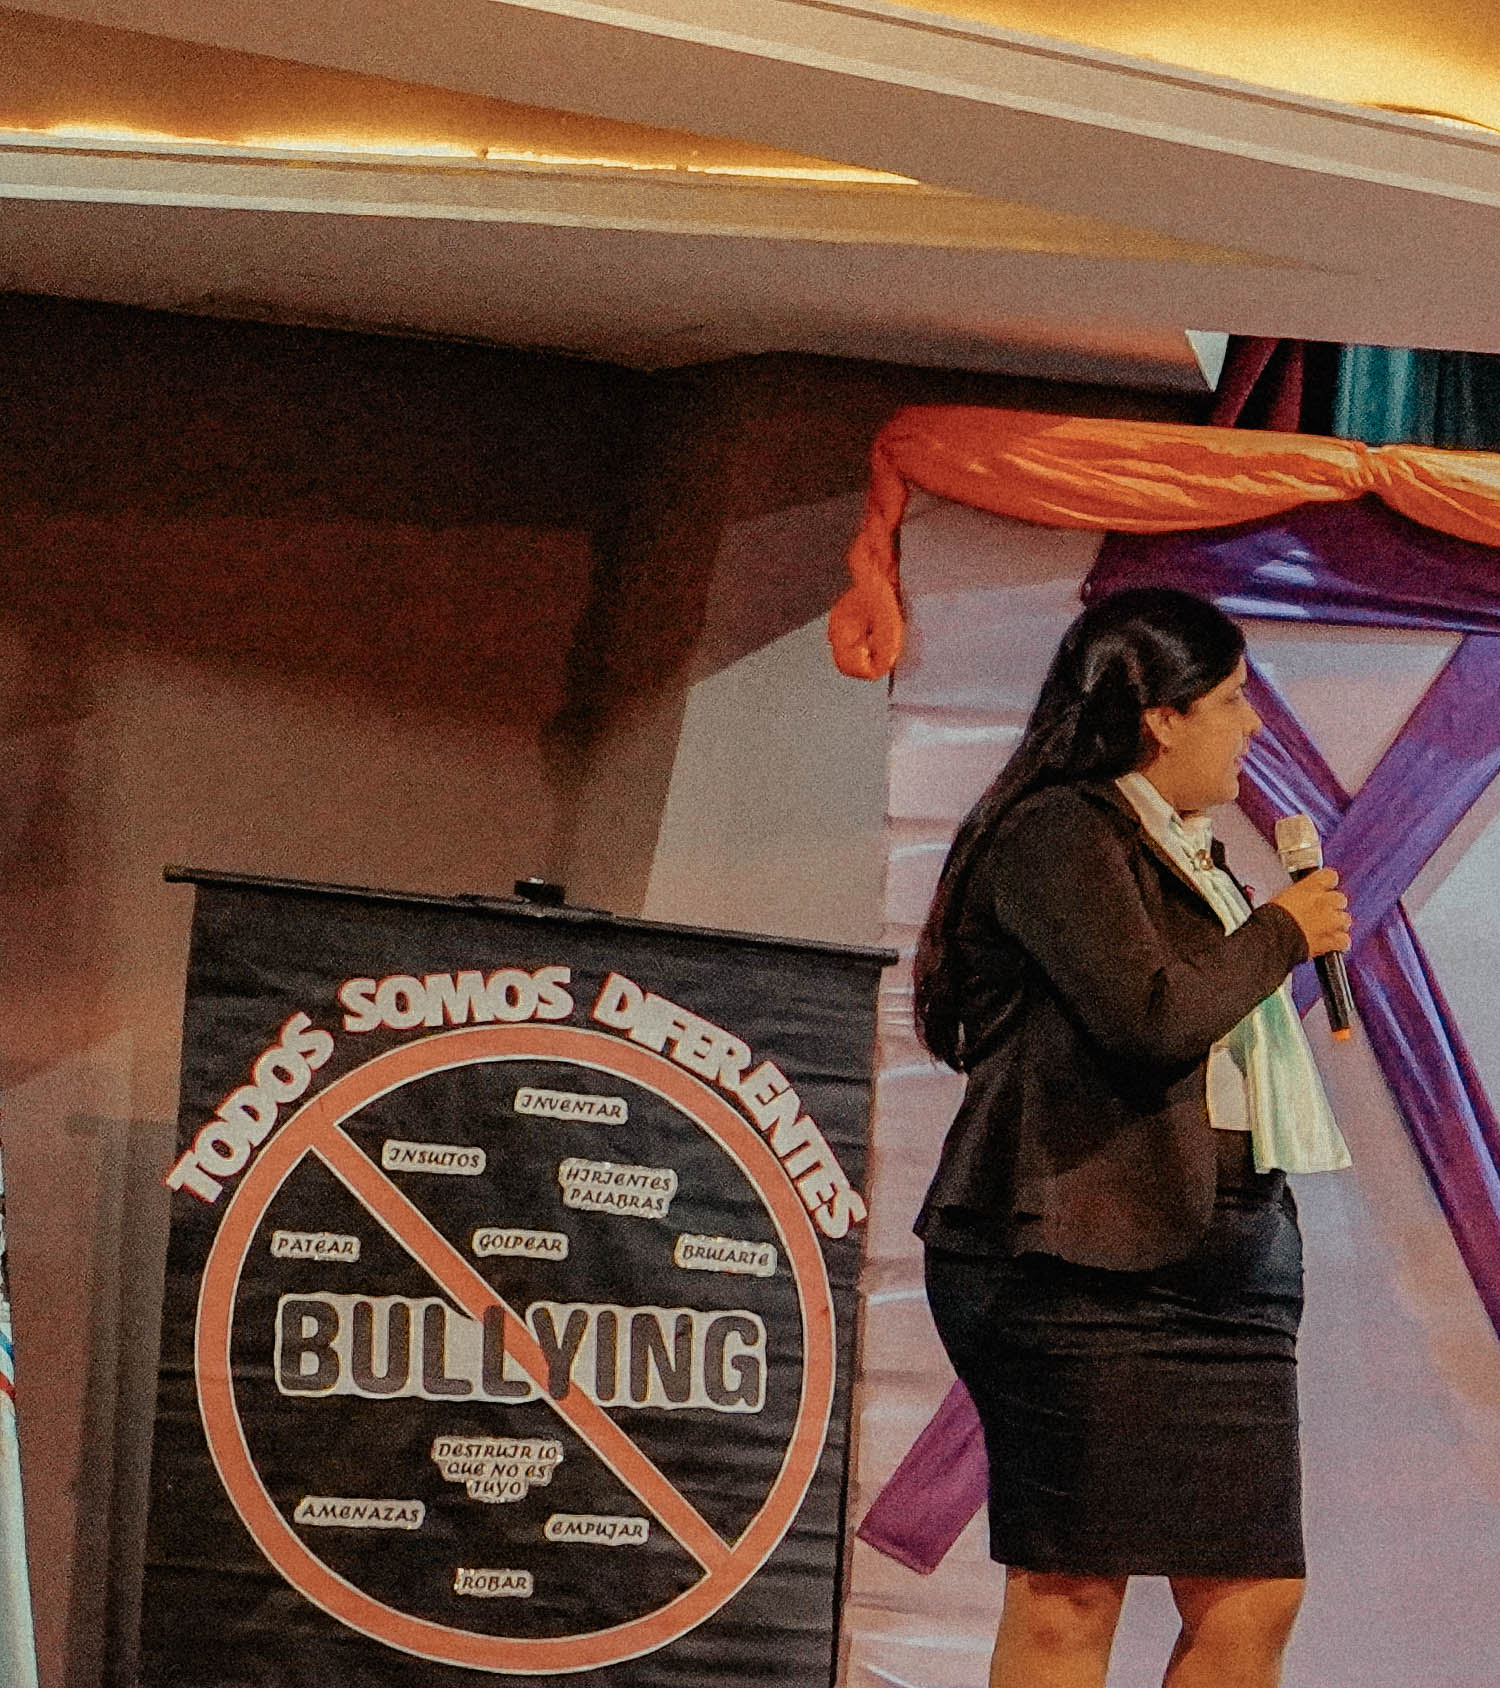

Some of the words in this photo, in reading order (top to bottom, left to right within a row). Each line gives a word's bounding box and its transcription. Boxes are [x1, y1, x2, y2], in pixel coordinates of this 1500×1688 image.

[164, 1012, 334, 1203] TODOS
[339, 966, 574, 1033] SOMOS
[591, 971, 867, 1238] DIFERENTES
[281, 1302, 761, 1406] BULLYING
[491, 1464, 518, 1477] NO
[462, 1576, 527, 1590] ROBAR
